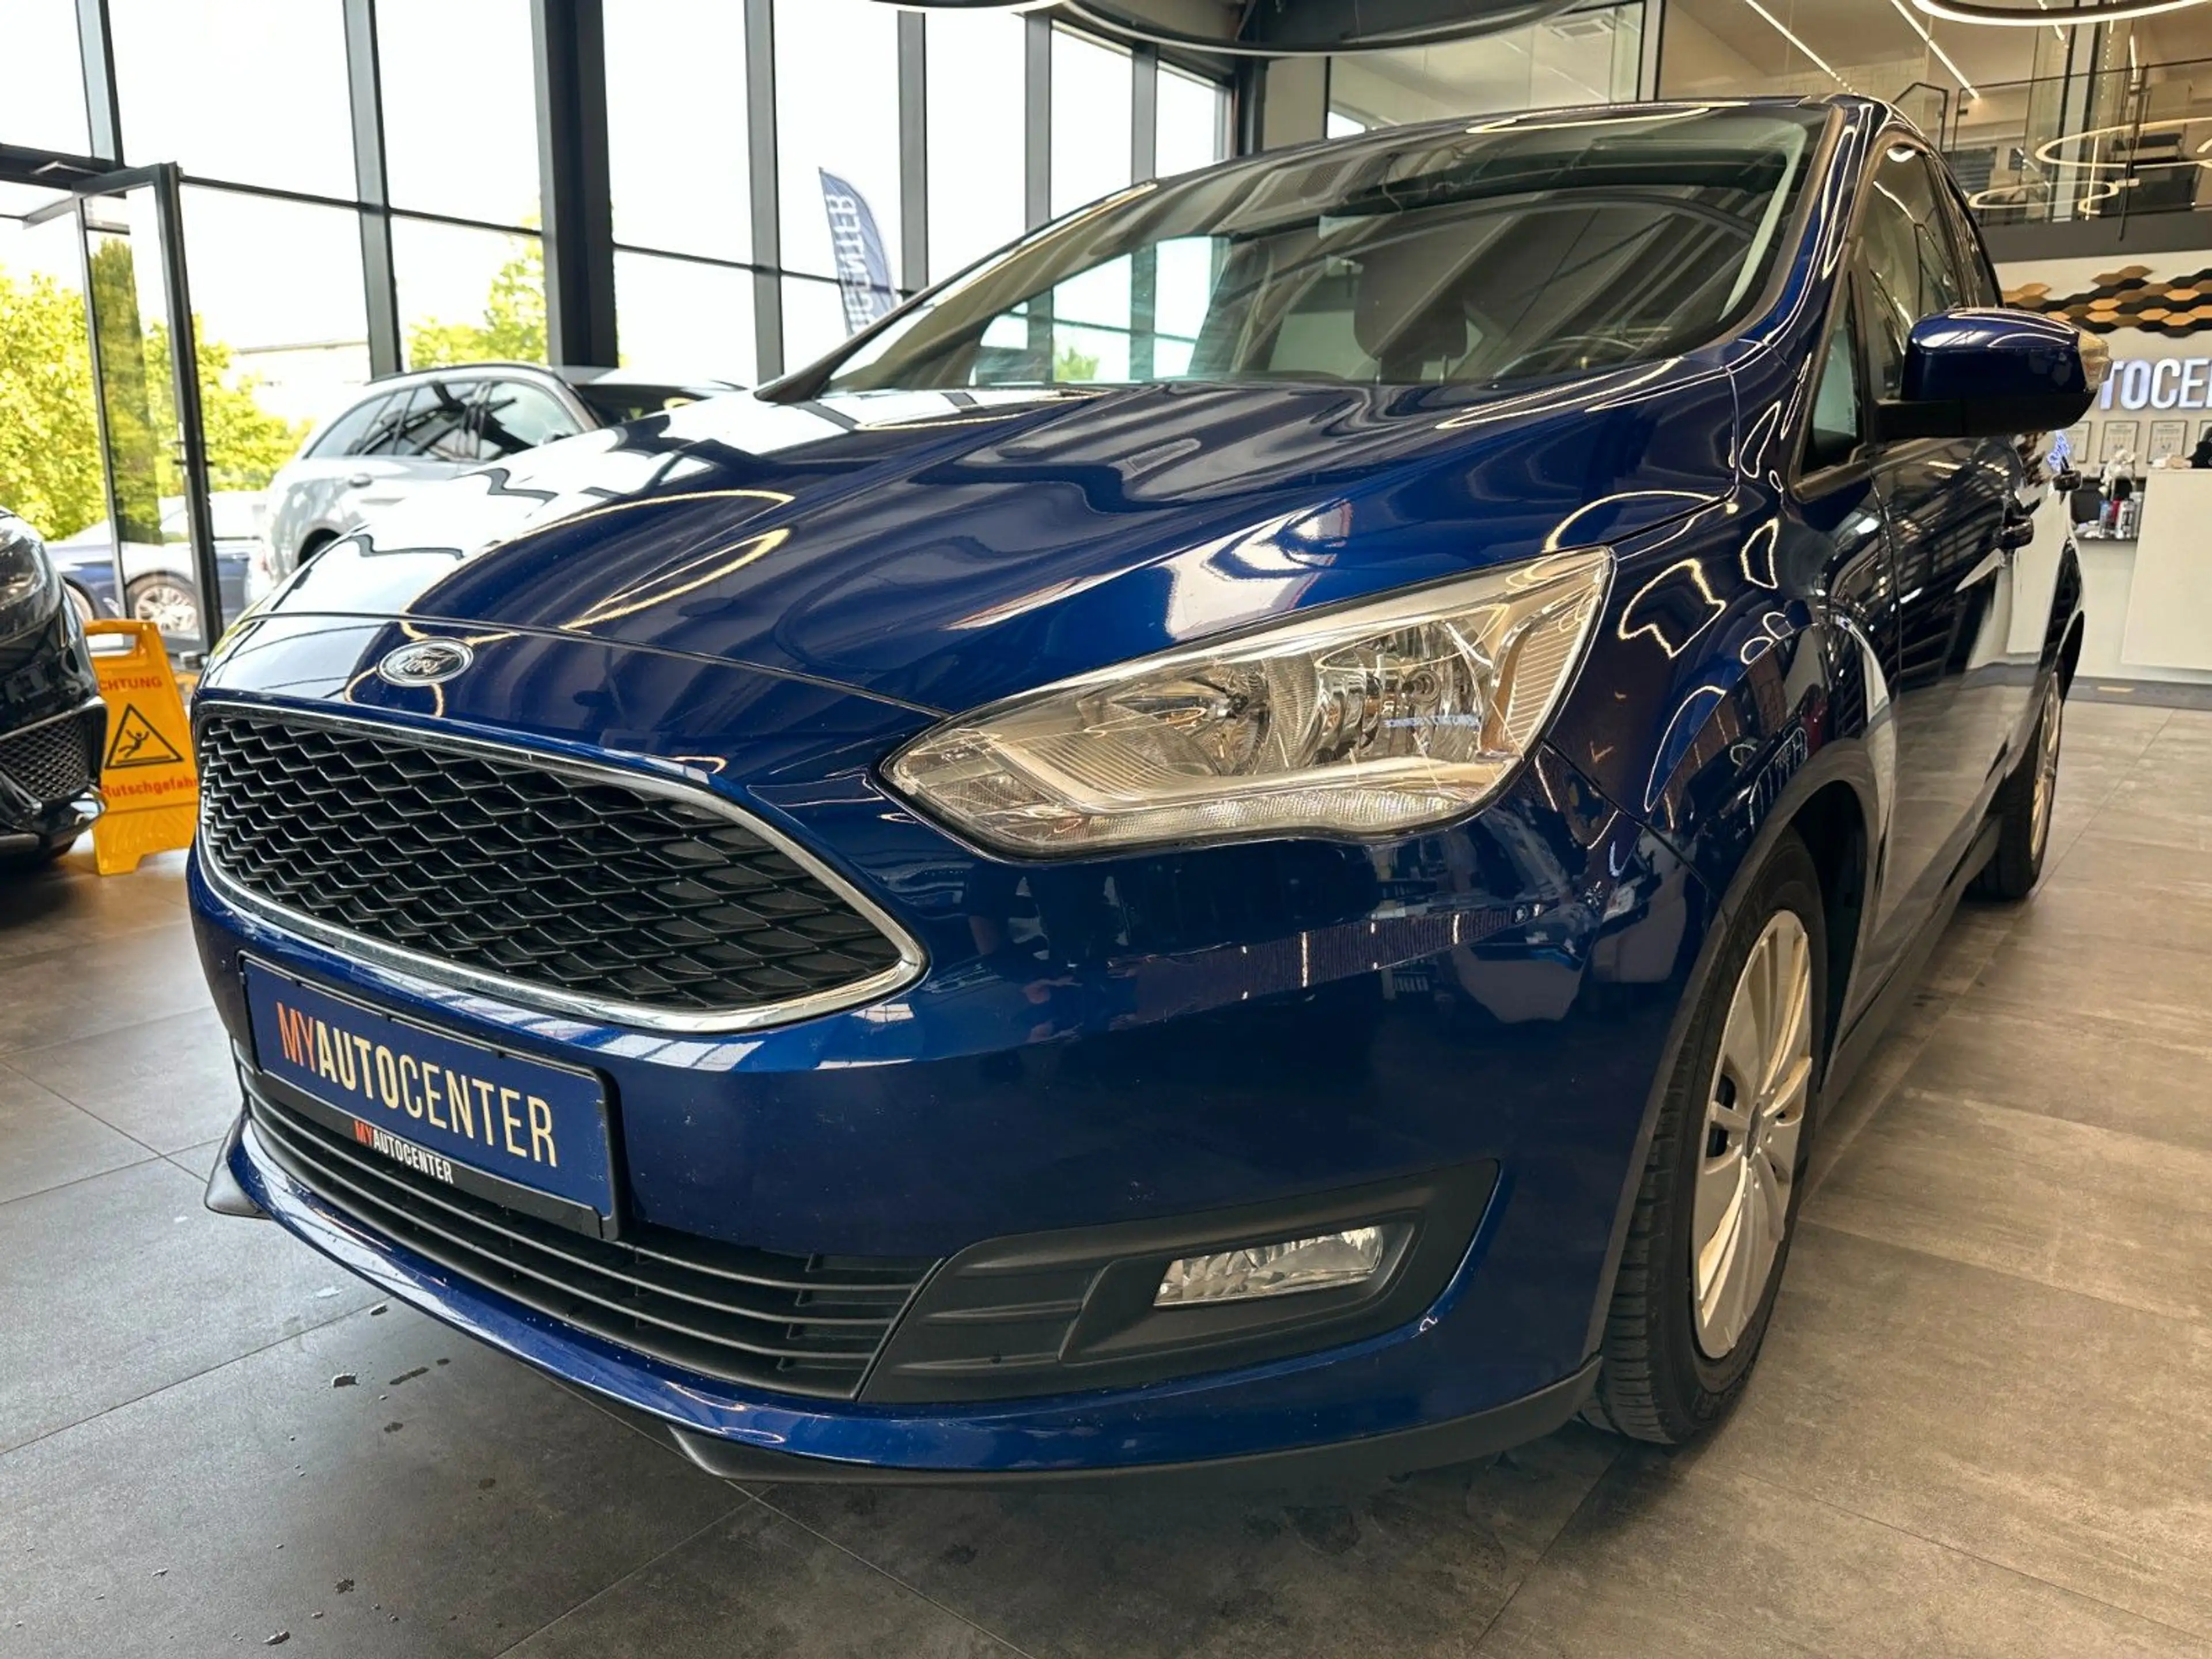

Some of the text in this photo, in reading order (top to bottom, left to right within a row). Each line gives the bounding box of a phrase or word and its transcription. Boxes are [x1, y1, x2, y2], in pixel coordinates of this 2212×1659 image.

[2100, 358, 2212, 410] TOCE
[276, 1002, 558, 1168] MYAUTOCENTER
[354, 1119, 454, 1184] MYAUTOCENTER
